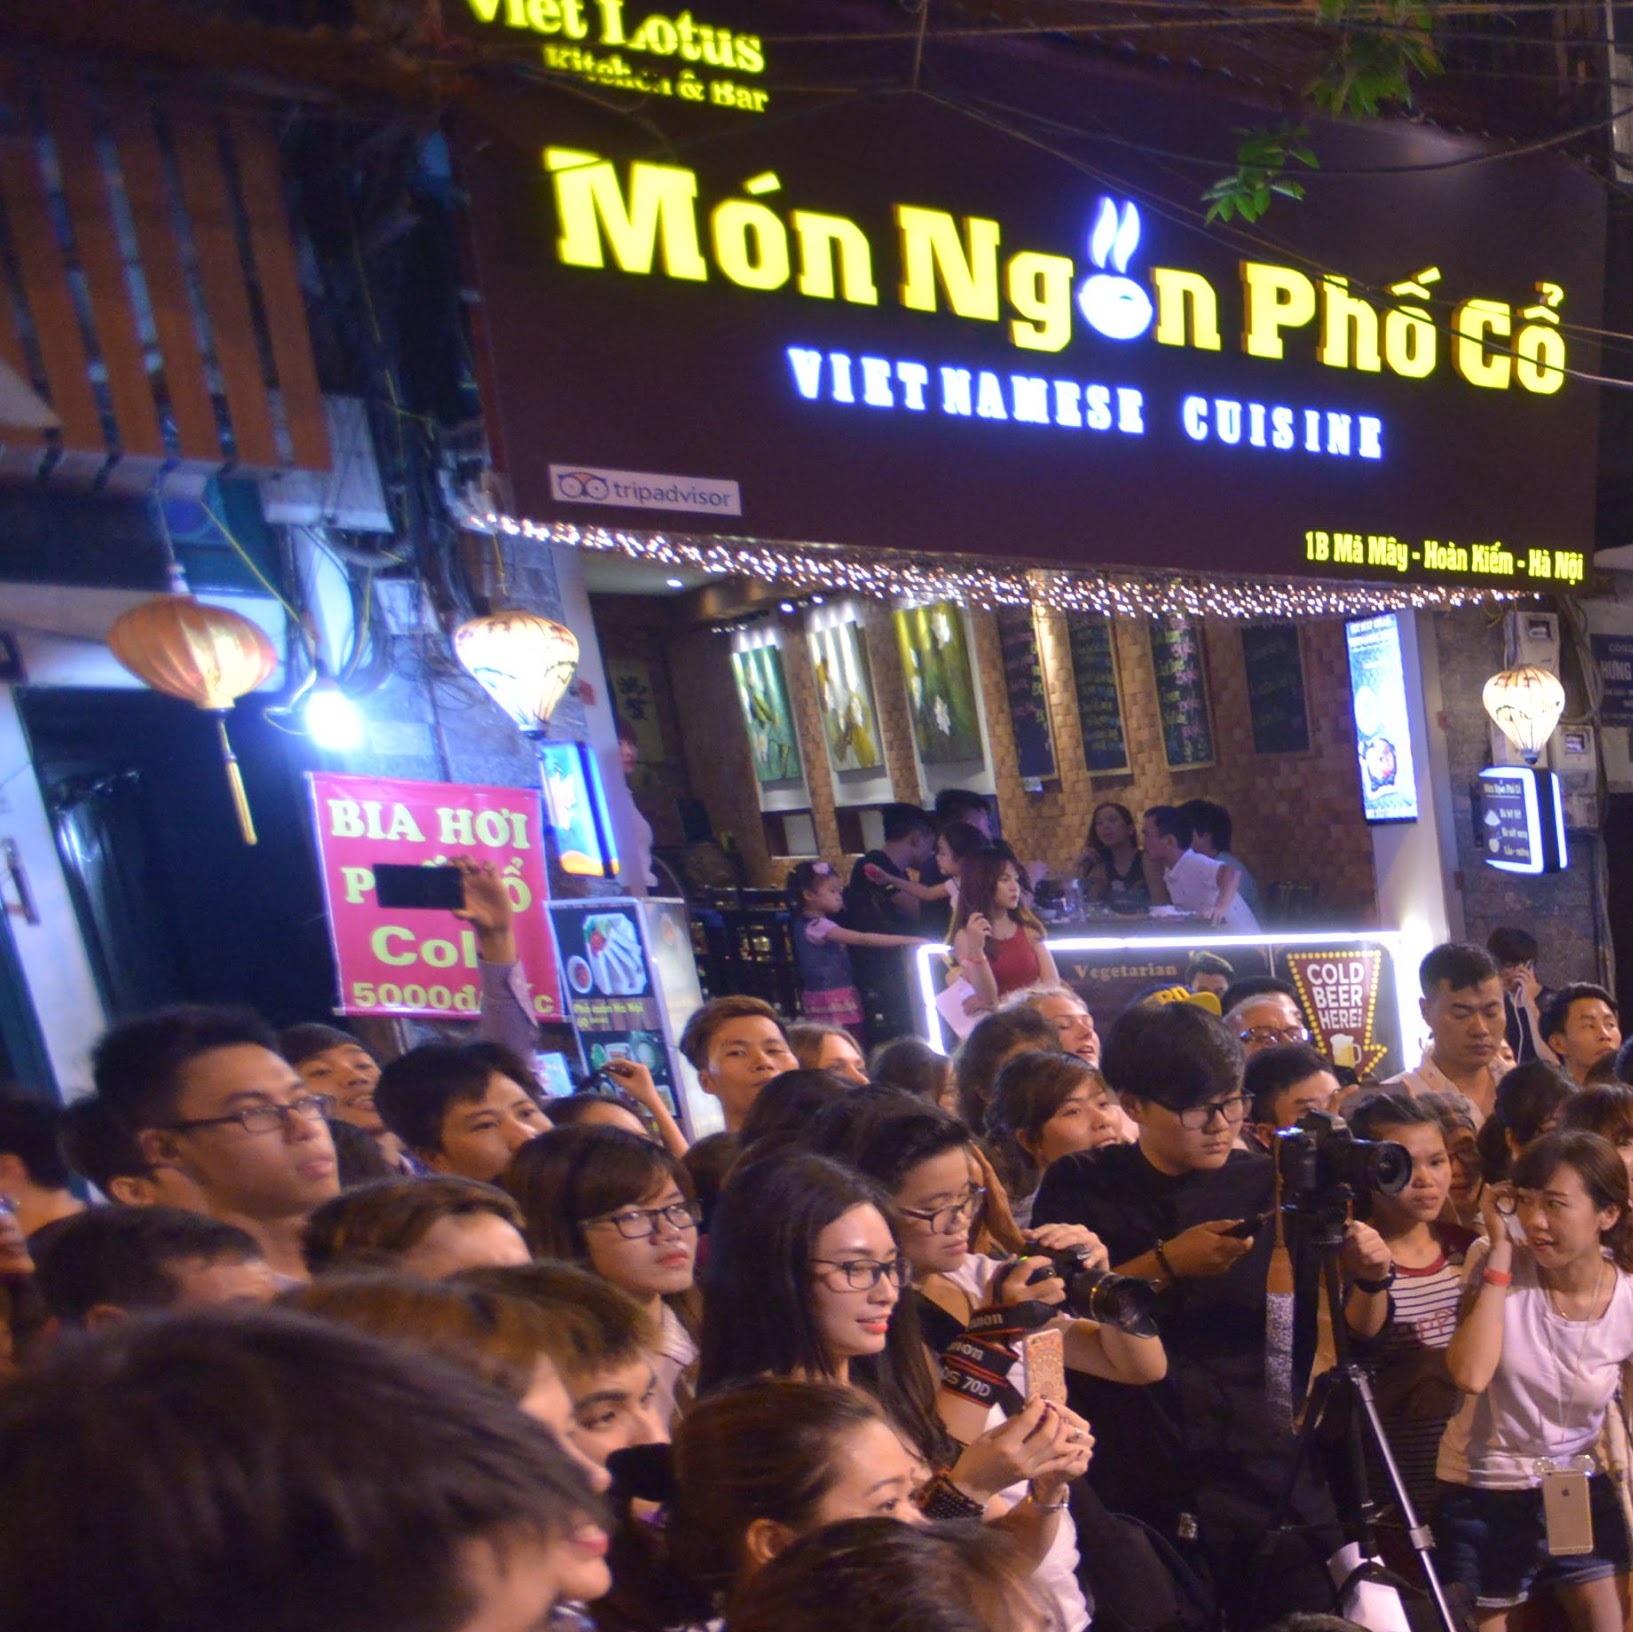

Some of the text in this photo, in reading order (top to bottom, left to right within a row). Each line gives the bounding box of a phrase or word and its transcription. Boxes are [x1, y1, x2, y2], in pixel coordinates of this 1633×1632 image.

[602, 0, 764, 73] Lotus
[710, 80, 769, 112] Bar
[545, 146, 877, 307] Món
[1239, 259, 1440, 379] Phố
[1452, 282, 1565, 396] Cổ
[786, 345, 1384, 461] VIETNAMESE CUISINE
[613, 481, 731, 506] tripadvisor
[1305, 531, 1330, 561] 1B
[1367, 536, 1408, 571] Mây
[1424, 540, 1468, 571] Hoàn
[1472, 541, 1514, 575] Kiếm
[1528, 549, 1551, 578] Hà
[1554, 551, 1583, 585] Nội
[327, 799, 531, 849] BIA HƠI
[371, 926, 480, 968] Col
[1074, 963, 1178, 982] Vegetarian
[1307, 962, 1364, 985] COLD
[1312, 984, 1363, 1008] BEER
[1318, 1008, 1362, 1029] HERE!
[962, 1376, 991, 1397] 70D
